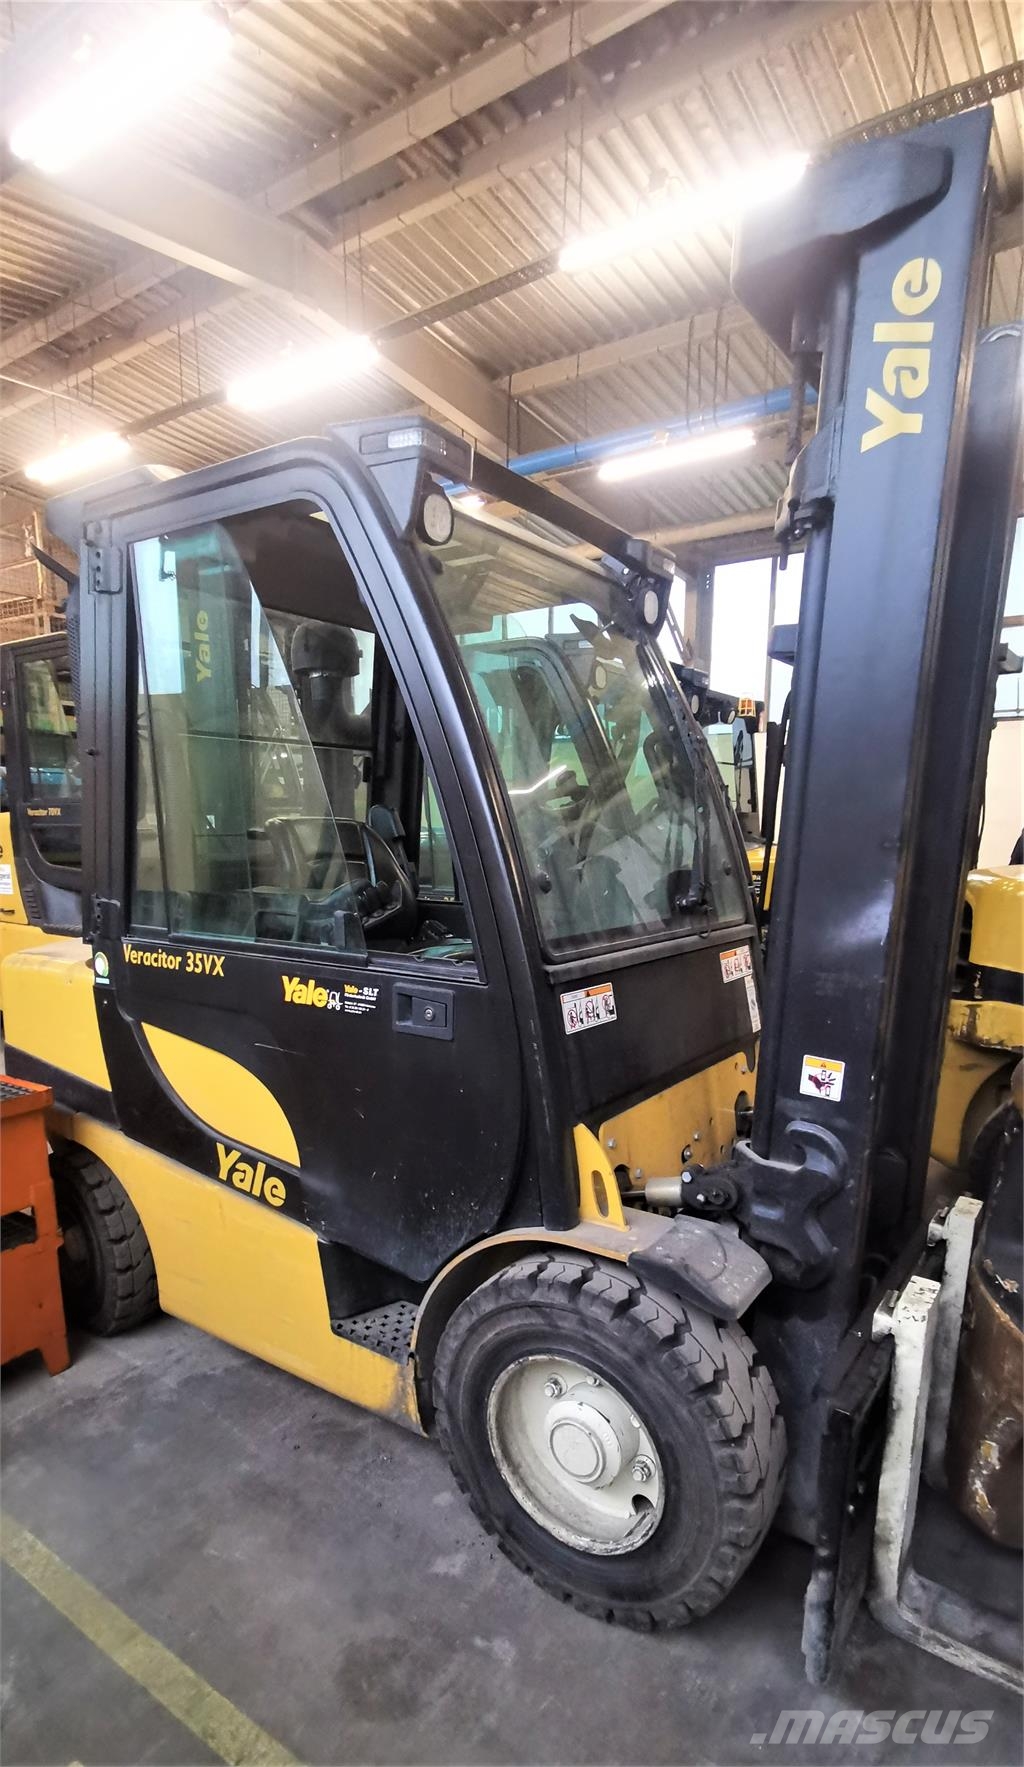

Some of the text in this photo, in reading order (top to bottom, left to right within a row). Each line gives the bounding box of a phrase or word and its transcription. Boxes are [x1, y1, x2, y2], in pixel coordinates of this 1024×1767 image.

[861, 257, 942, 453] Yale
[195, 610, 211, 682] Yale
[123, 943, 226, 977] Veracitor 35VX
[281, 975, 328, 1008] Yale
[216, 1142, 286, 1207] Yale
